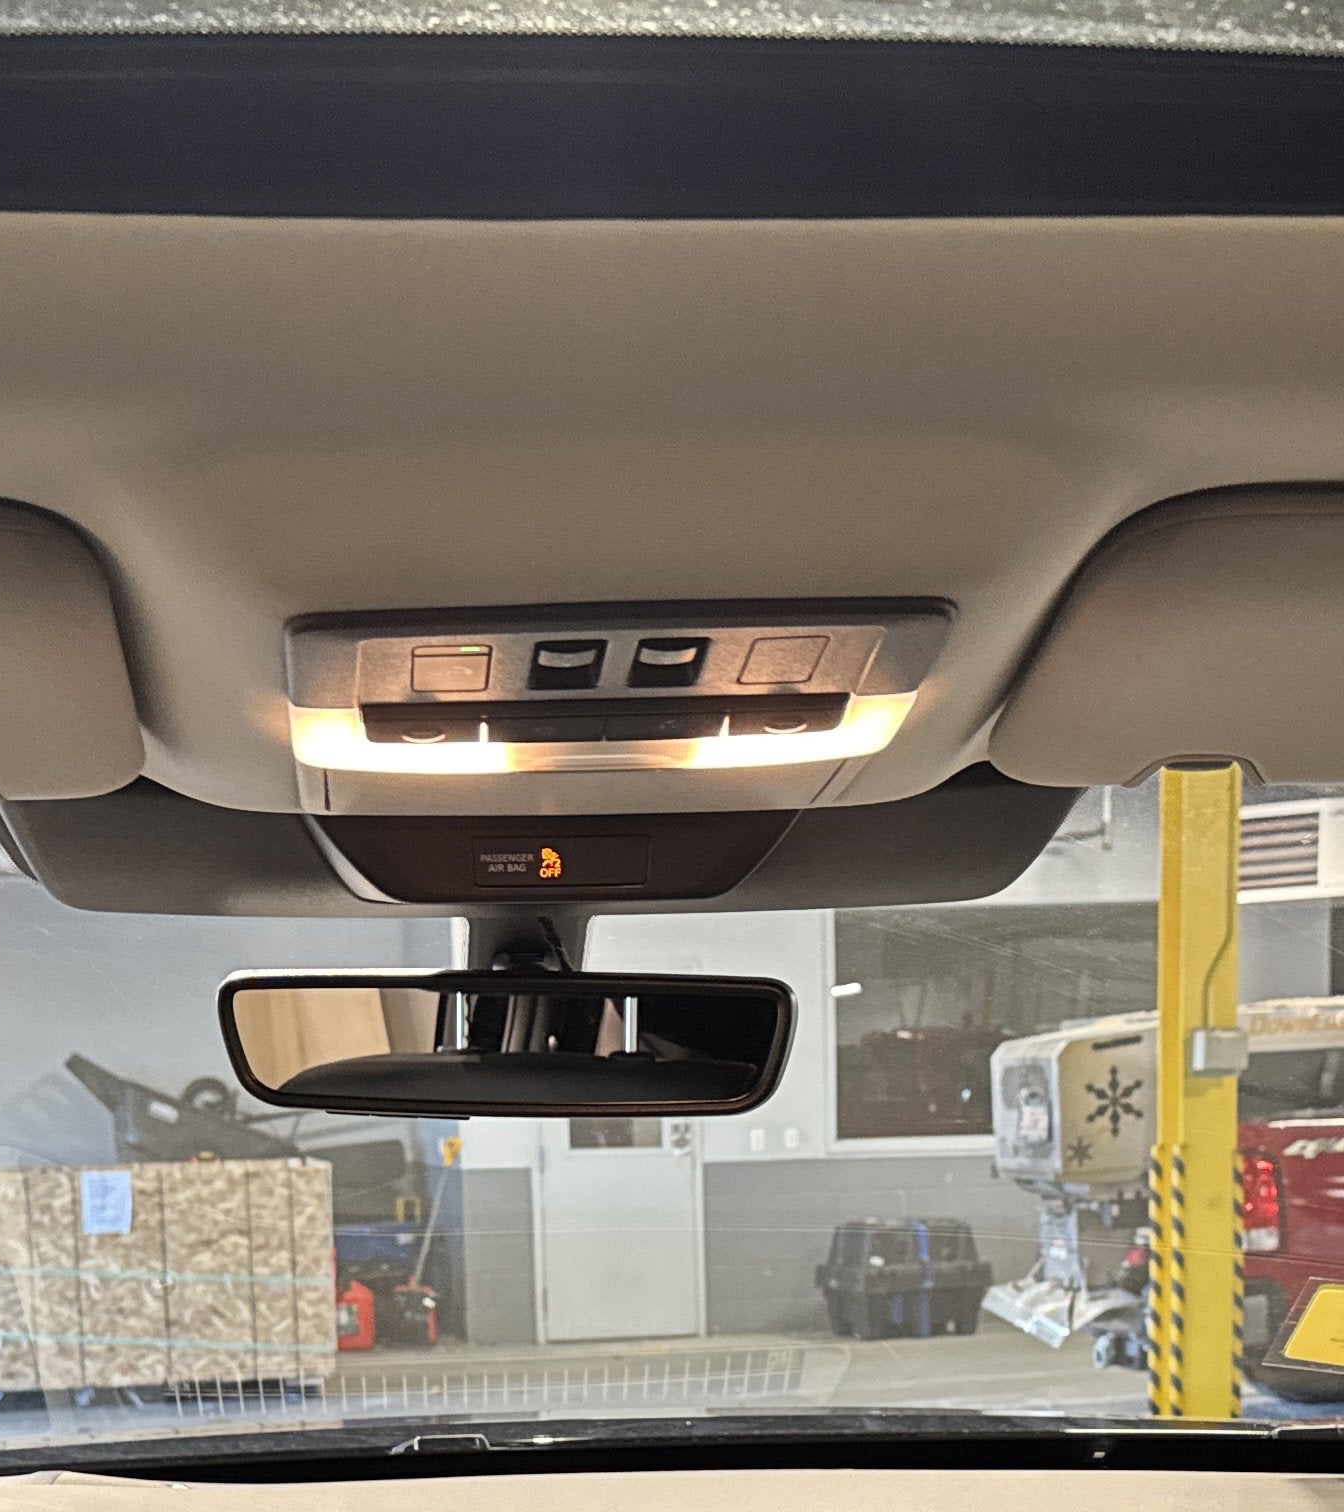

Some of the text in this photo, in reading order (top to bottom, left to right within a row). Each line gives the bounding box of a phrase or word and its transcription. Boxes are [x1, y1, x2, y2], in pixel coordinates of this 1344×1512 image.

[480, 853, 534, 862] PASSENGER
[488, 863, 527, 873] AIR BAG
[539, 868, 561, 878] OFF
